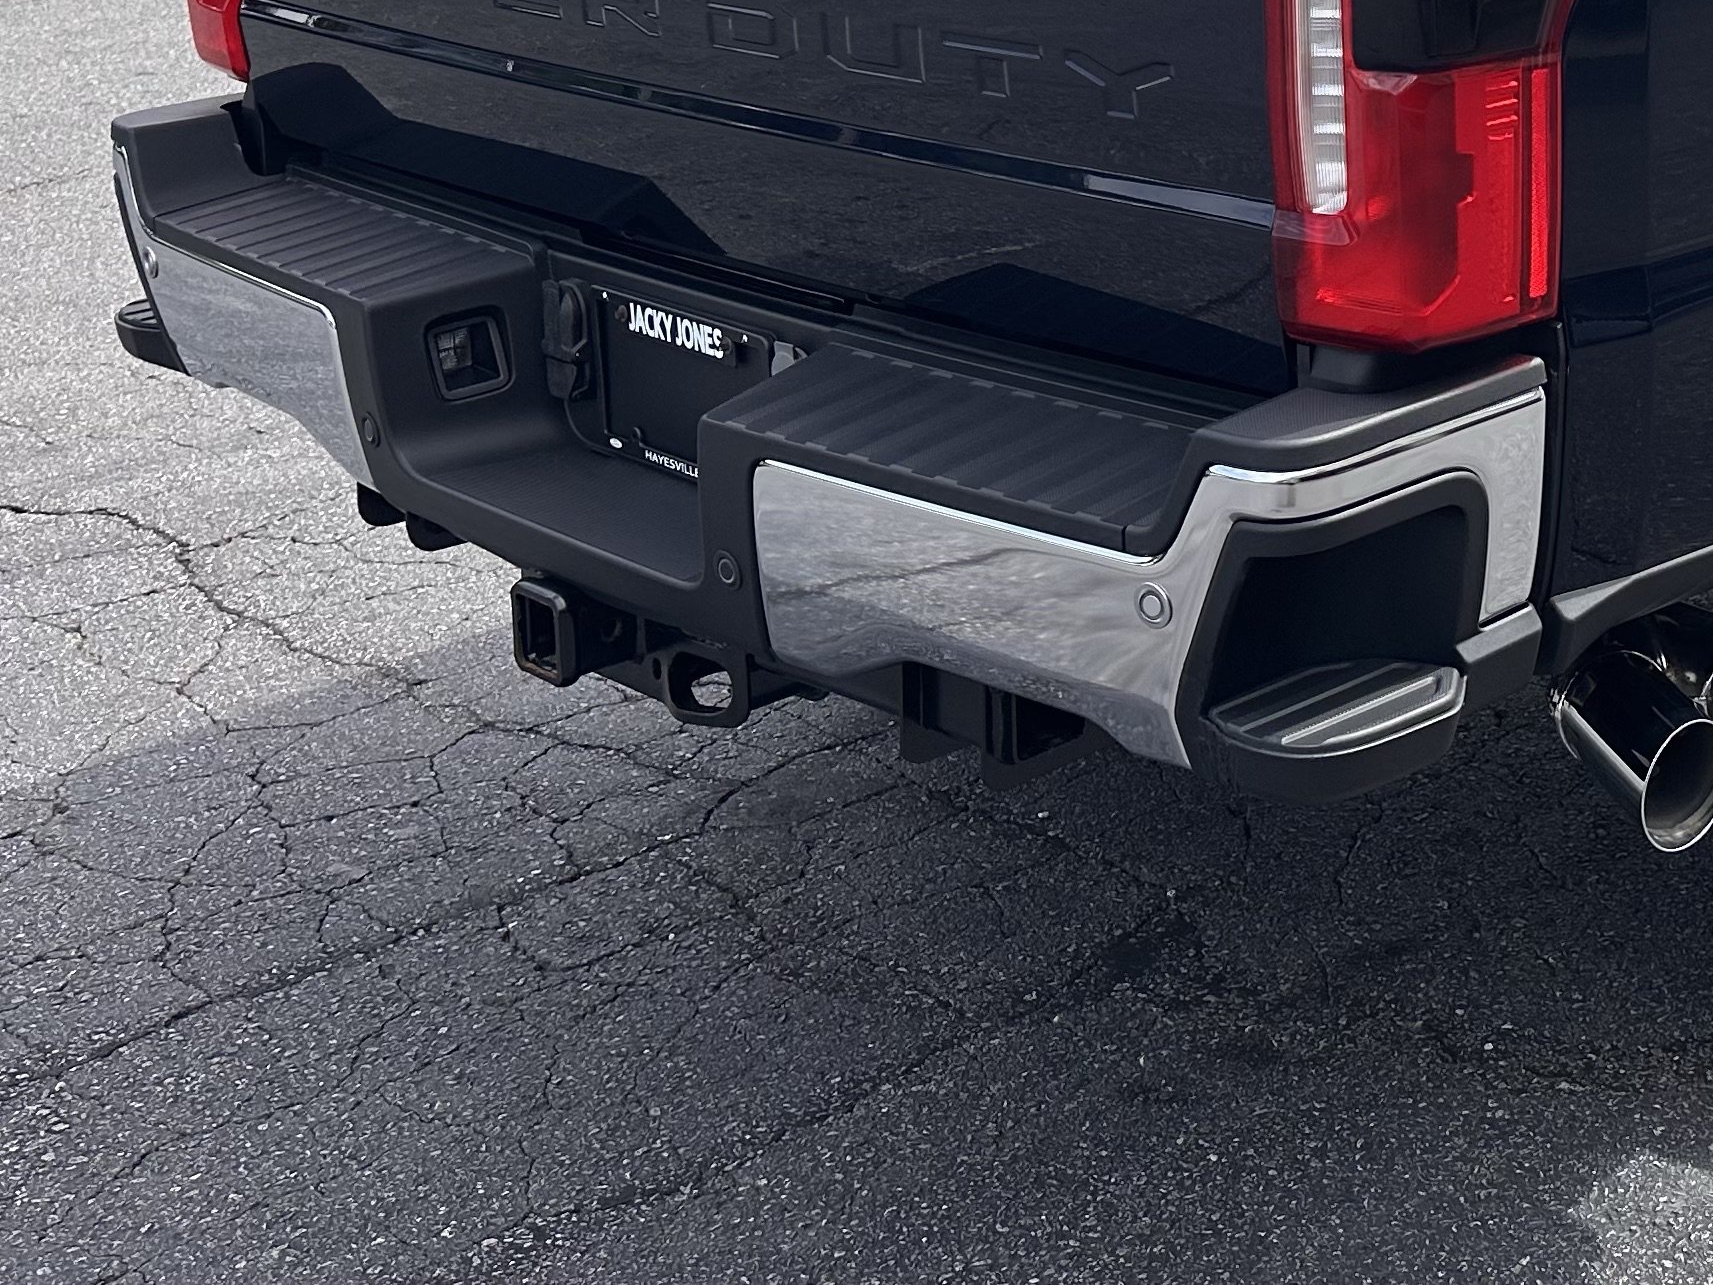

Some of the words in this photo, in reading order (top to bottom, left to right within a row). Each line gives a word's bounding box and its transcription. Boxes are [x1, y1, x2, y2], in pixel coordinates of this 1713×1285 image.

[628, 302, 673, 343] JACKY
[676, 316, 724, 359] JONES
[644, 449, 699, 479] HAYESVILLE
